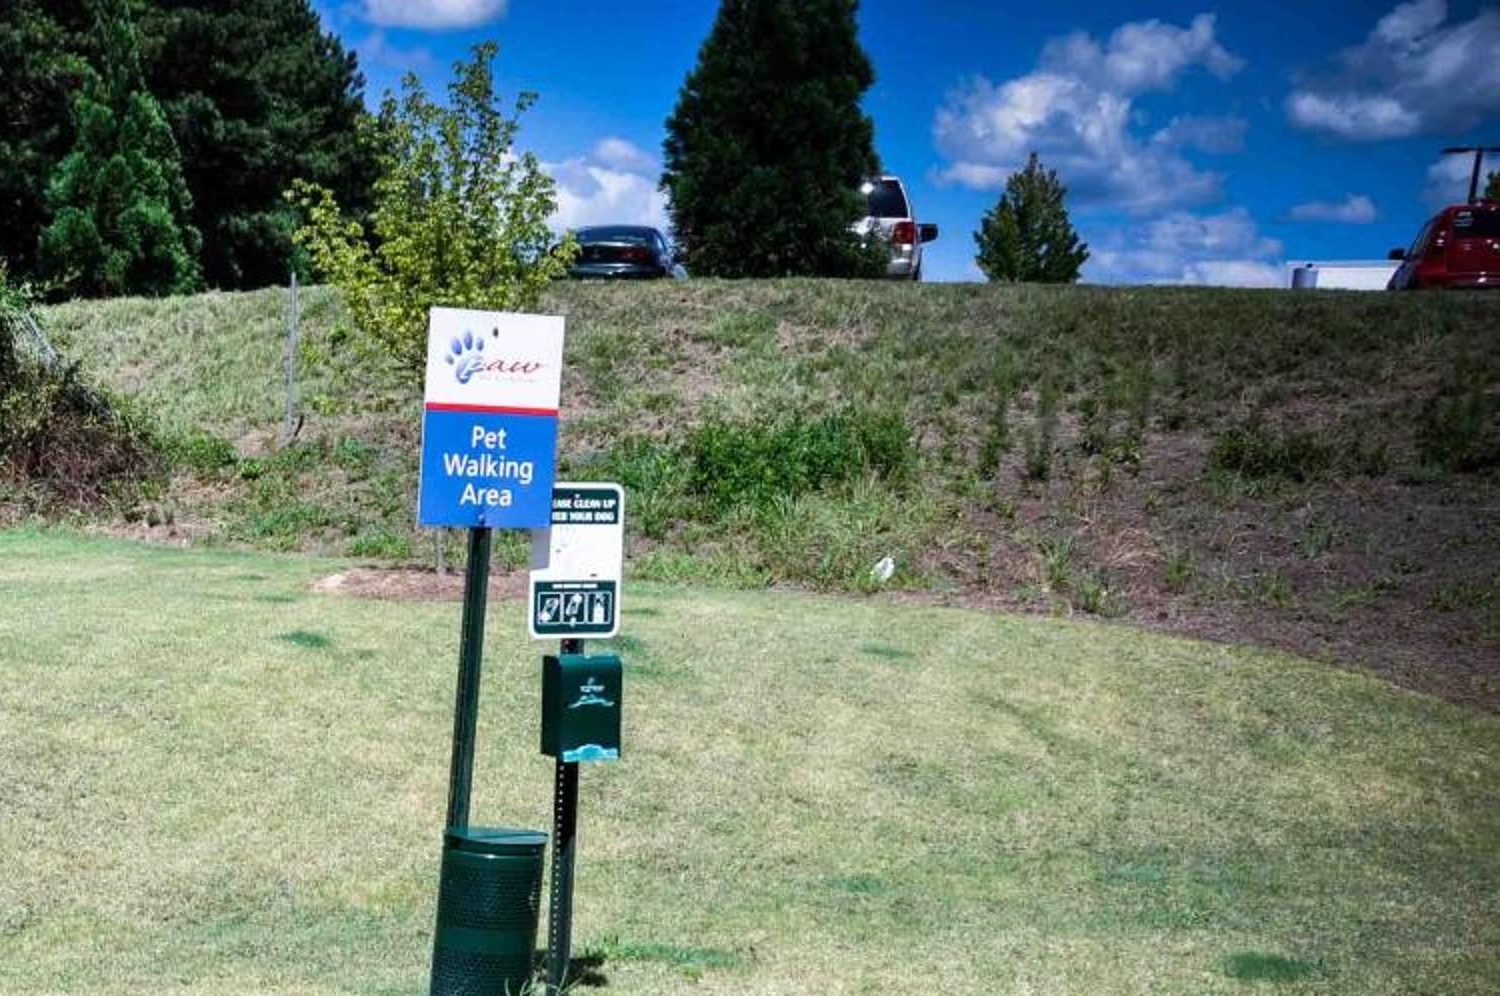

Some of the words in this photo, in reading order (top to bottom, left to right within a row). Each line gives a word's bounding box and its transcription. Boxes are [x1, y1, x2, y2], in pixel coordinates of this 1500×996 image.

[471, 426, 507, 449] Pet
[443, 453, 534, 484] Walking
[459, 484, 513, 507] Area
[603, 499, 616, 508] UP
[594, 511, 615, 521] DOG
